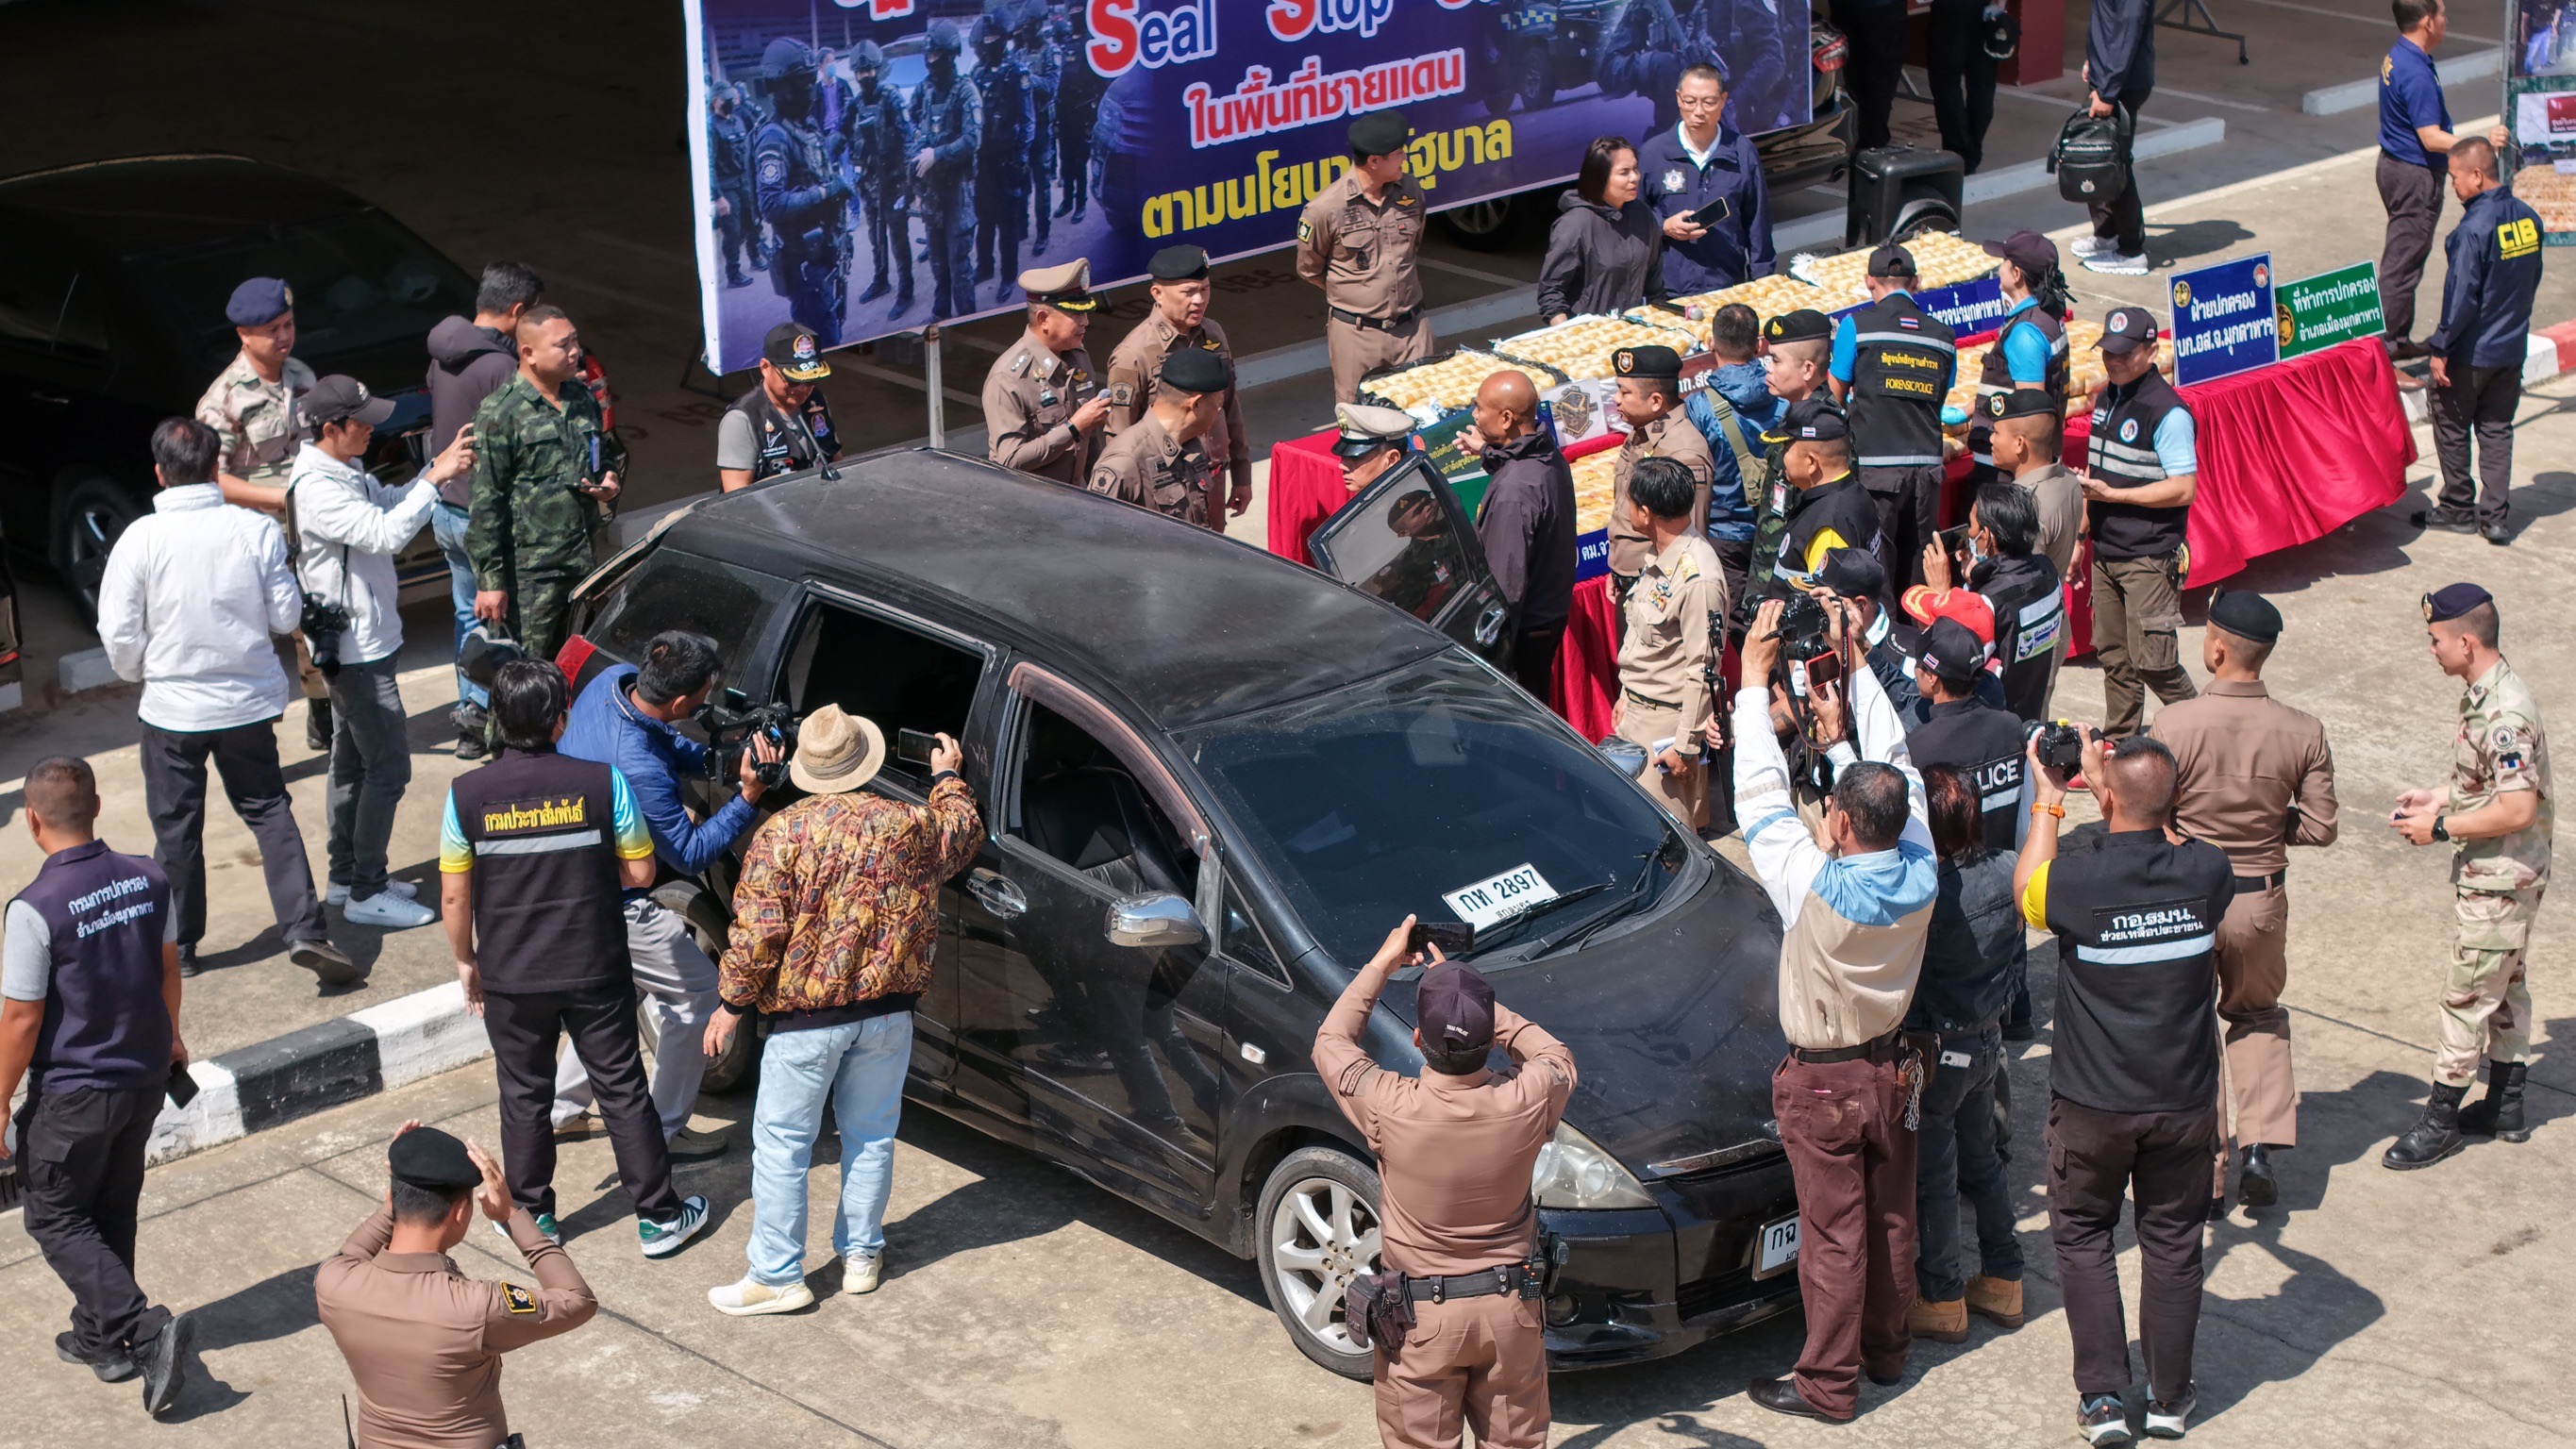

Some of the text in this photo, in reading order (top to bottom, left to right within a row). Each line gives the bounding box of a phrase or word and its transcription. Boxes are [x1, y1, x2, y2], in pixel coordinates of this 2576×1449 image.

[1087, 0, 1215, 76] Seal
[1184, 49, 1464, 147] ในพื้นที่ชายแดน
[1142, 119, 1512, 239] ตามนโยบาฐบาล
[2498, 218, 2538, 250] CIB
[2191, 291, 2256, 322] ฝ่ายปกครอง
[2293, 276, 2377, 313] ที่ทำการปกครอง
[2176, 316, 2274, 358] บก.อส.จ.มุกดาหาร
[2300, 307, 2381, 341] อำเภอเมืองมุกดาหาร
[1885, 378, 1933, 395] FORENSIC POLICE
[1976, 758, 2018, 791] LICE
[484, 796, 583, 832] กรมประชาสัมพันธ์
[68, 875, 149, 915] กรมการปกครอง
[1493, 869, 1539, 899] 2897
[2100, 921, 2204, 942] ช่วยเหลือประชาชน
[2112, 908, 2196, 930] กอ.รมน.
